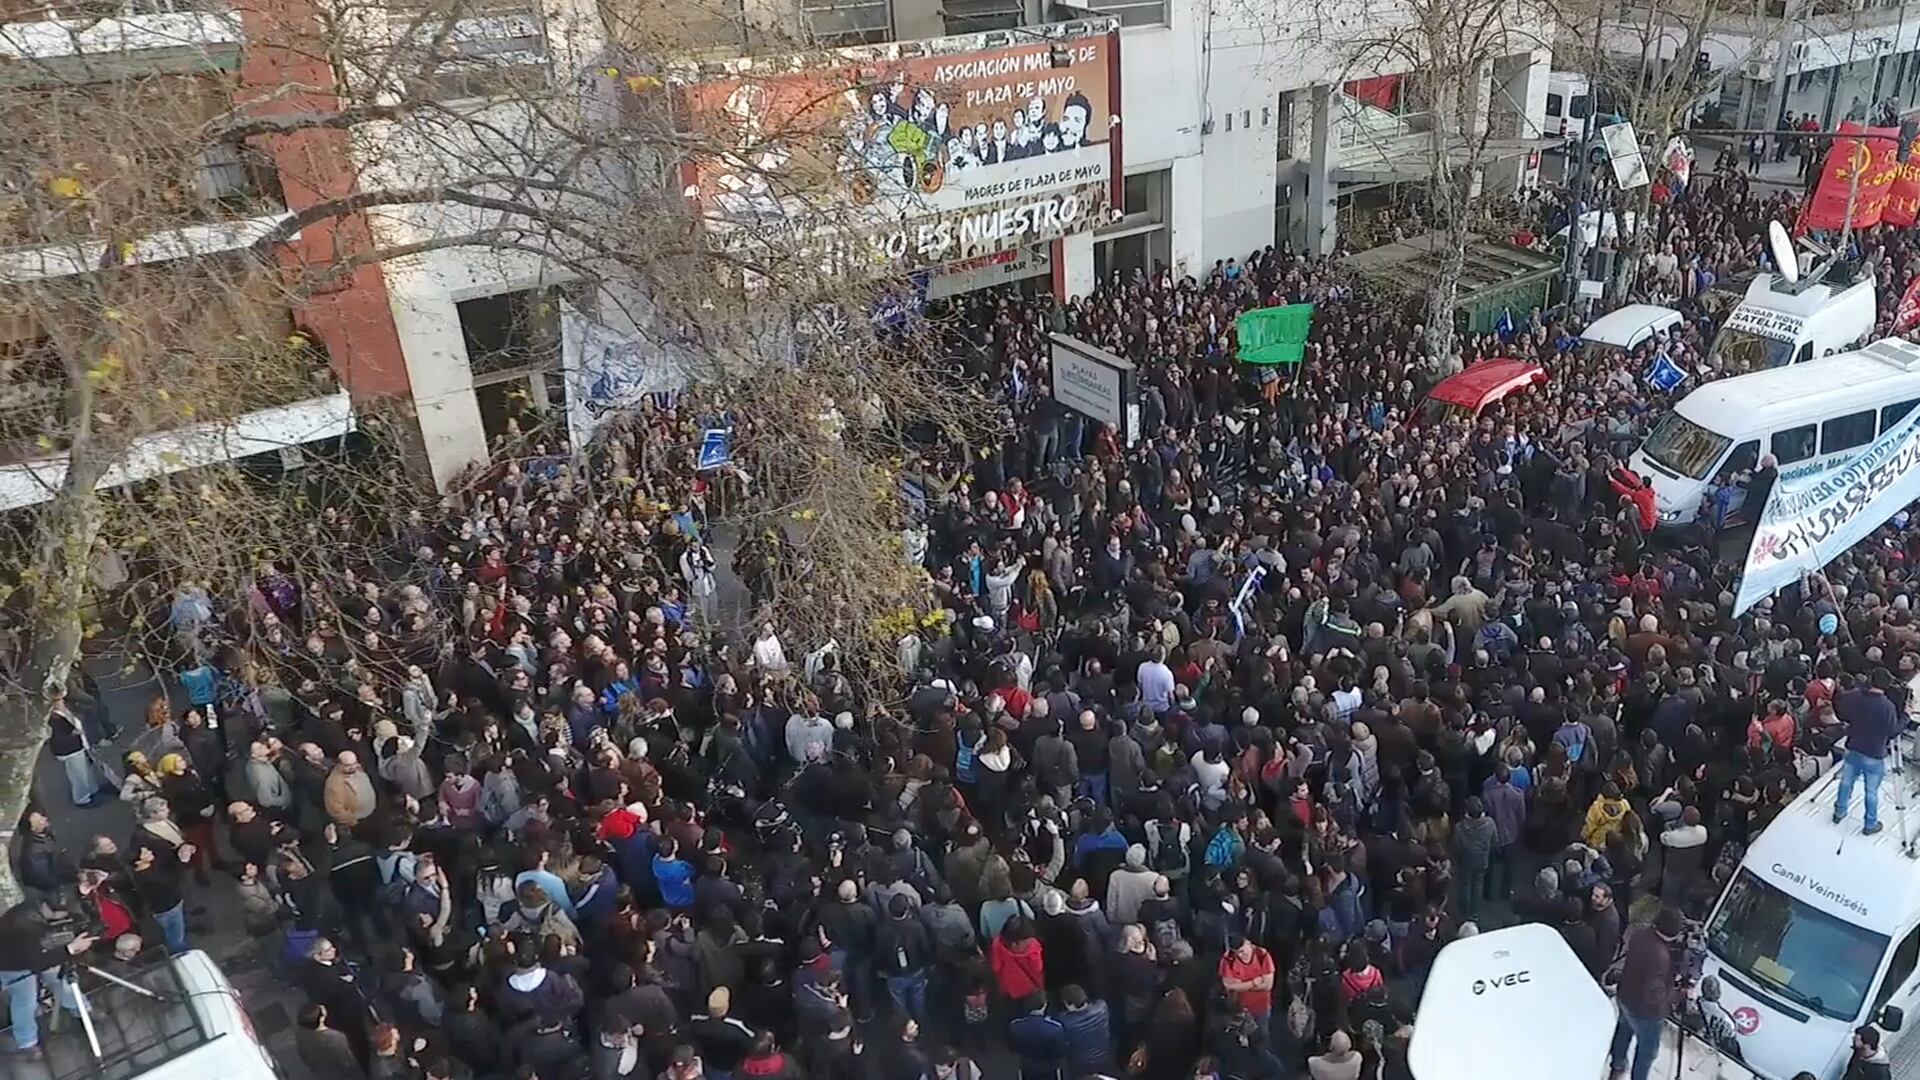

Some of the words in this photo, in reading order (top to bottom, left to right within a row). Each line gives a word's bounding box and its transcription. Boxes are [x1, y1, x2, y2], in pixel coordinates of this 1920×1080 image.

[934, 53, 1019, 84] ASOCIACIÓN
[1023, 48, 1075, 72] MADS
[1078, 45, 1098, 63] DE
[966, 85, 1012, 108] PLAZA
[1015, 83, 1034, 98] DE
[1038, 75, 1075, 97] MAYO
[964, 181, 1006, 201] MADRES
[1008, 179, 1022, 193] DE
[1024, 171, 1056, 190] PLAZA
[1059, 168, 1073, 182] DE
[1073, 164, 1102, 180] MAYO
[917, 219, 951, 254] ES
[959, 195, 1078, 244] NUESTRO
[1004, 261, 1026, 273] BAR
[1733, 312, 1800, 335] SATELITAL
[1738, 305, 1773, 319] UNIDAD
[1775, 314, 1804, 327] MOVIL
[1779, 459, 1824, 482] sociación
[1771, 863, 1807, 886] Canal
[1809, 879, 1869, 916] Veintiséis
[1490, 970, 1531, 988] VEC
[1734, 1010, 1757, 1029] 26
